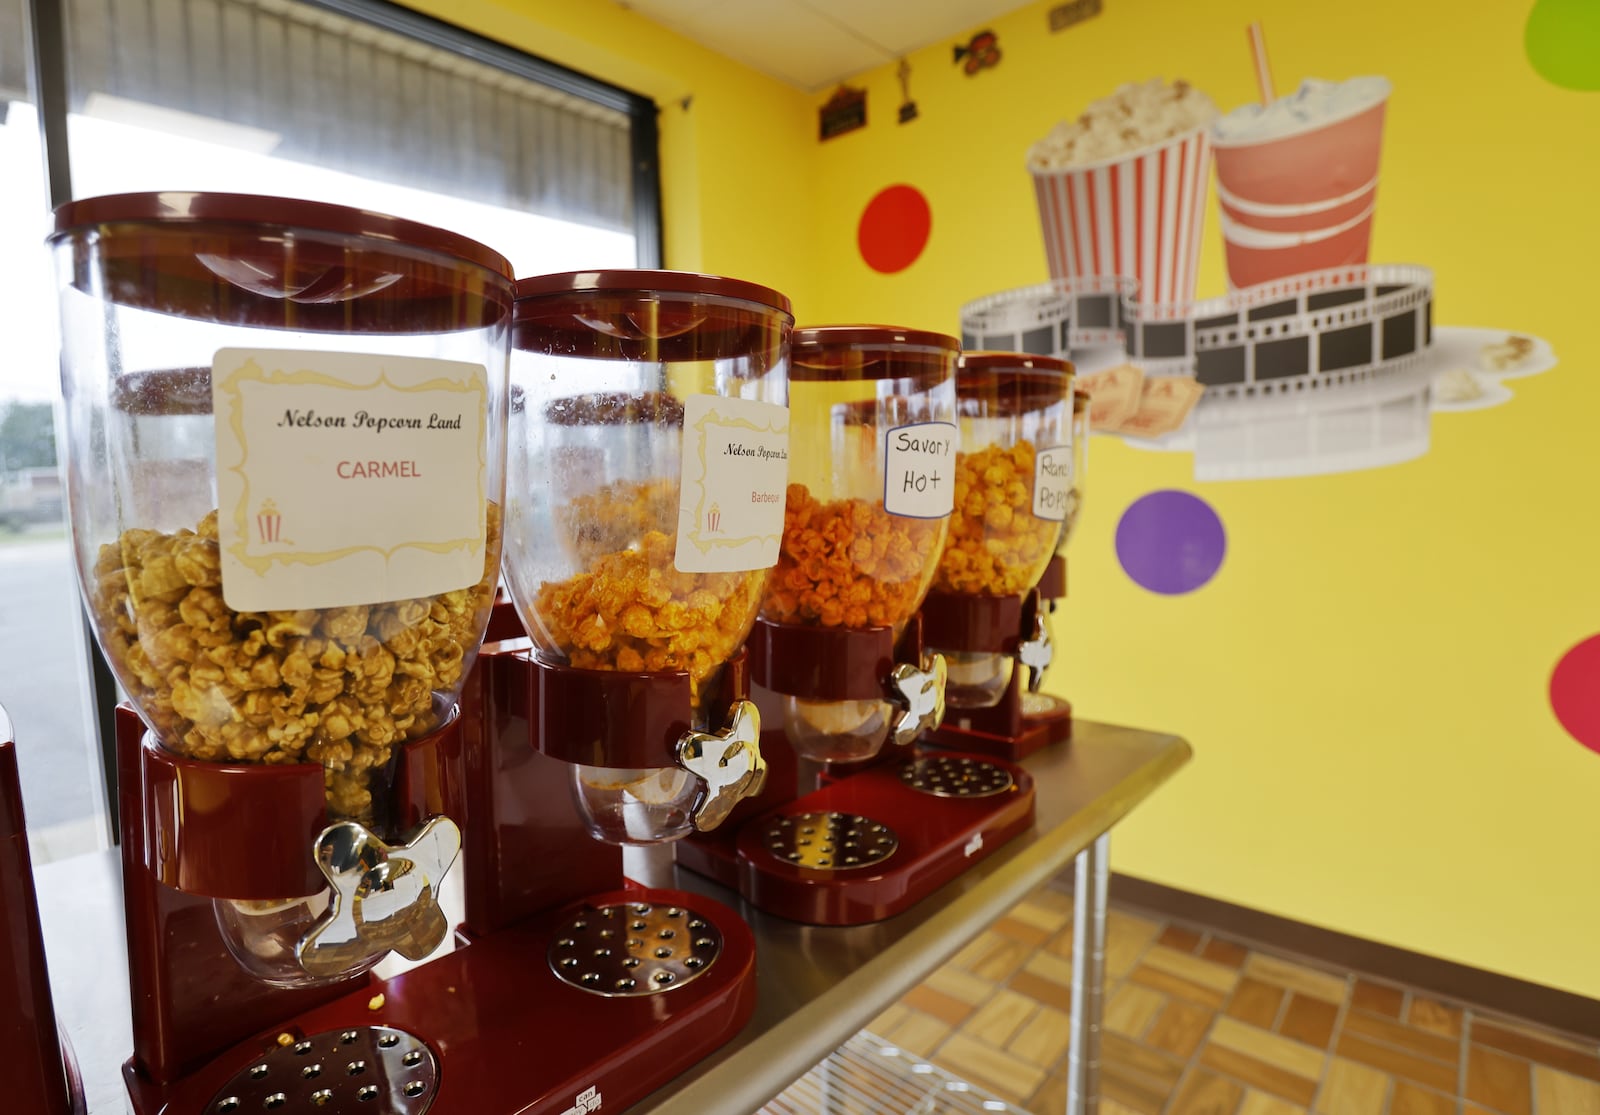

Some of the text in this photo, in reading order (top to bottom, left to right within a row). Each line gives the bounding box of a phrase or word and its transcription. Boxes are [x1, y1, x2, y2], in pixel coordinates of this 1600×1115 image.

[277, 409, 462, 434] Nelson Popcorn Land
[723, 443, 755, 457] Nelson
[896, 433, 951, 456] Savory
[336, 461, 421, 479] CARMEL
[579, 1091, 593, 1102] can
